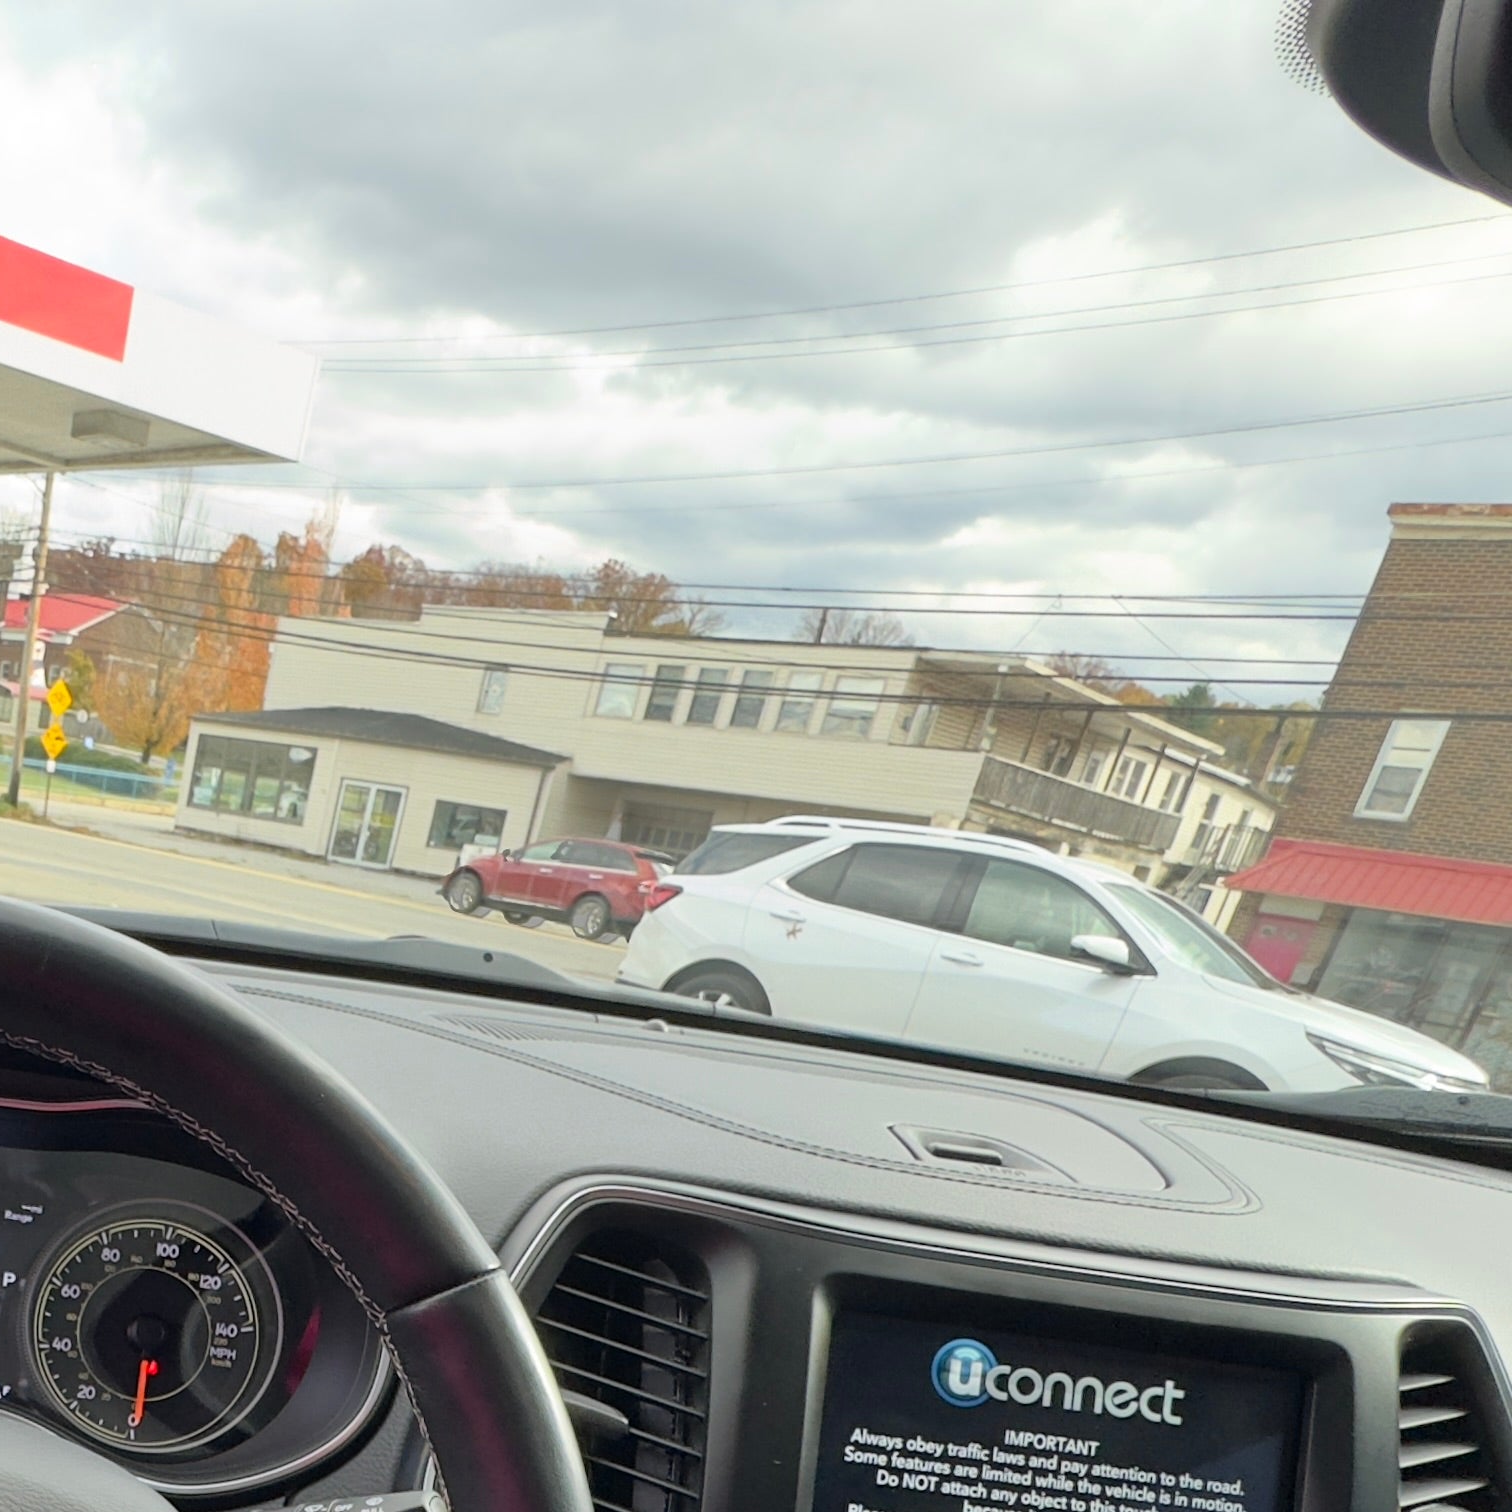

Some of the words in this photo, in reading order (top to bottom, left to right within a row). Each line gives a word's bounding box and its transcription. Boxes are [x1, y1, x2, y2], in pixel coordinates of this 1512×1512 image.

[101, 1247, 120, 1263] 80
[156, 1242, 180, 1259] 100
[2, 1272, 17, 1287] P
[199, 1274, 221, 1290] 120
[61, 1285, 81, 1300] 60
[215, 1322, 238, 1338] 140
[52, 1336, 72, 1352] 40
[210, 1345, 237, 1360] MPH
[2, 1385, 11, 1396] F
[77, 1384, 96, 1400] 20
[128, 1413, 140, 1427] 0
[1004, 1429, 1100, 1457] IMPORTANT
[850, 1428, 904, 1451] Always
[906, 1435, 944, 1457] obey
[947, 1442, 989, 1460] traffic
[993, 1447, 1025, 1466] laws
[1029, 1455, 1057, 1470] and
[1061, 1460, 1088, 1476] pay
[1091, 1466, 1156, 1484] attention
[1160, 1472, 1175, 1486] to
[1179, 1473, 1203, 1490] the
[1207, 1479, 1245, 1496] road.
[844, 1446, 887, 1466] Some
[891, 1452, 951, 1475] features
[953, 1466, 978, 1479] are
[982, 1464, 1032, 1486] limited
[1036, 1474, 1073, 1492] while
[1077, 1478, 1101, 1495] the
[1106, 1483, 1156, 1503] vehicle
[1160, 1490, 1170, 1505] is
[1174, 1492, 1188, 1507] in
[876, 1469, 899, 1487] Do
[903, 1473, 939, 1492] NOT
[941, 1480, 986, 1499] attach
[990, 1487, 1018, 1505] any
[1021, 1489, 1067, 1510] object
[1071, 1499, 1086, 1512] to
